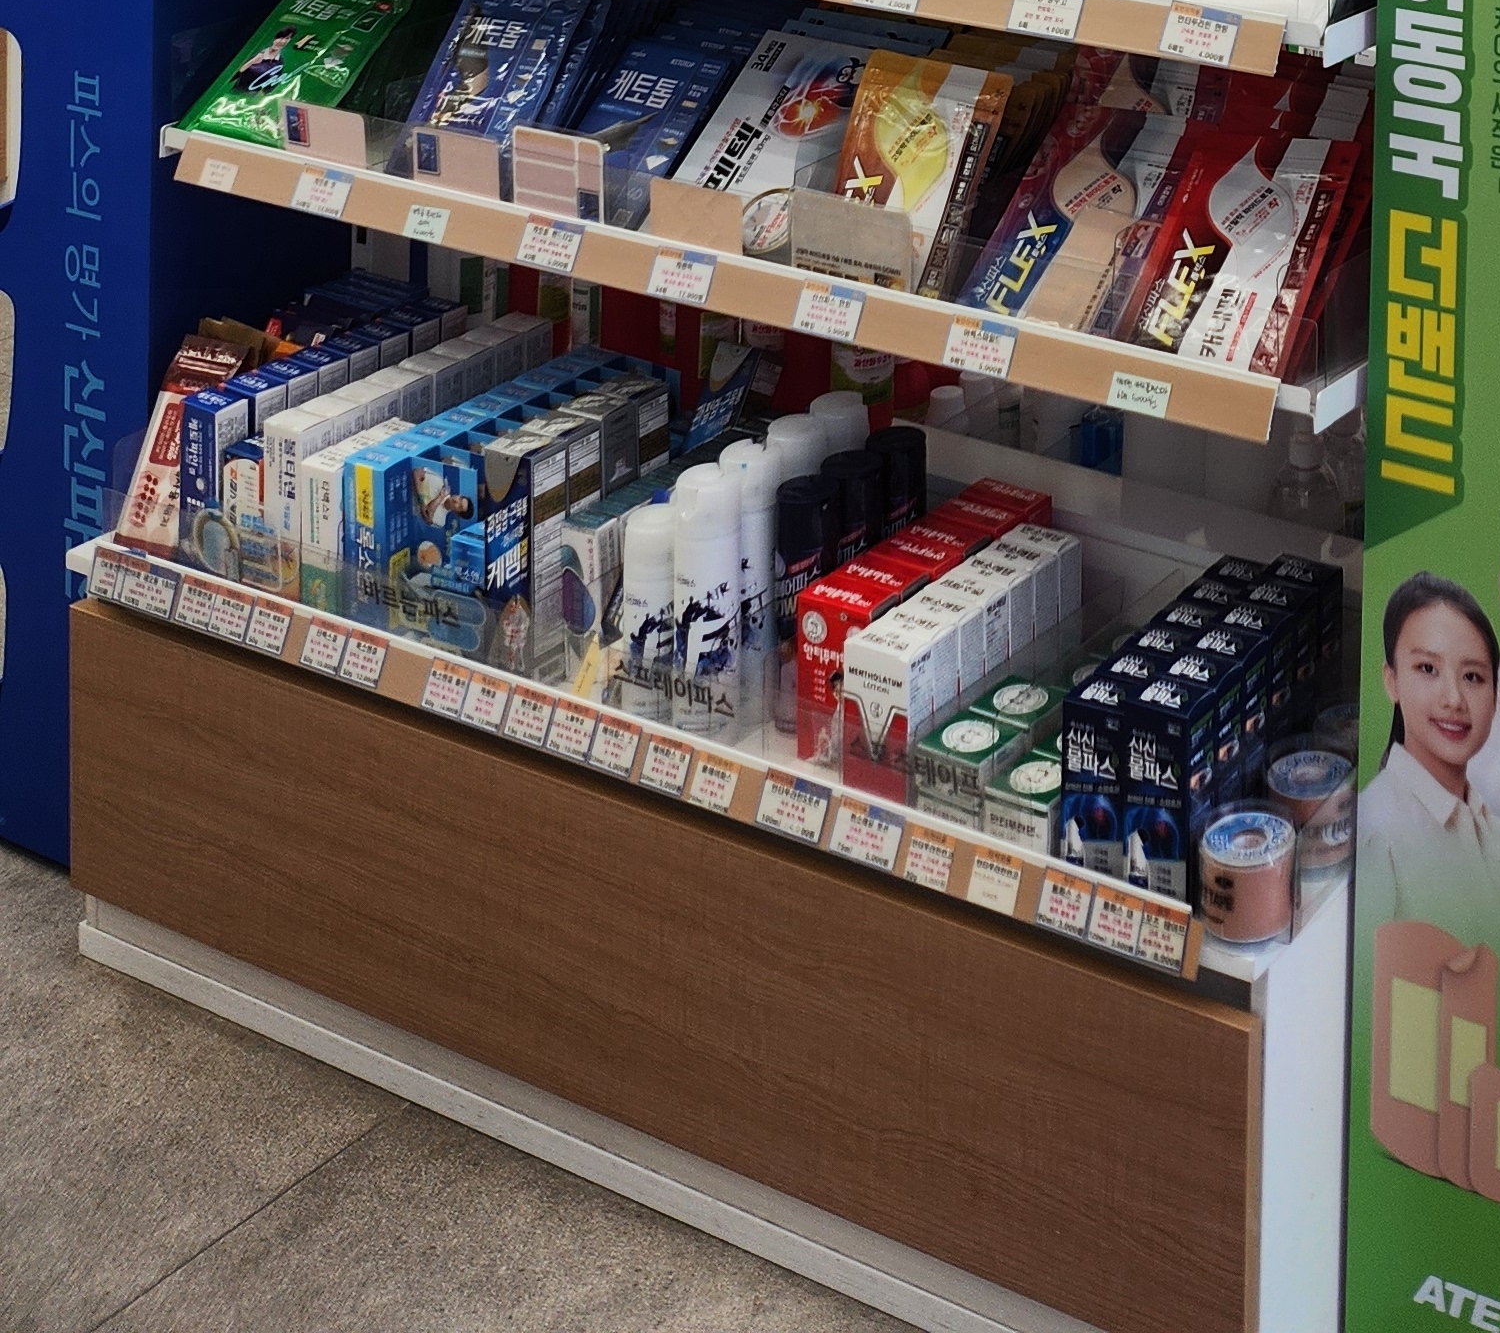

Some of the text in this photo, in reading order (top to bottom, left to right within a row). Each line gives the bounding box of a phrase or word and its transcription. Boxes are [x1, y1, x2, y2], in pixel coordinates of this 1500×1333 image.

[66, 70, 103, 222] 파스의
[606, 68, 681, 110] 케토톱
[985, 209, 1058, 316] FLEX
[1149, 226, 1216, 347] FLEX
[1380, 210, 1458, 496] 더밴드
[613, 660, 735, 718] 스프레이파스
